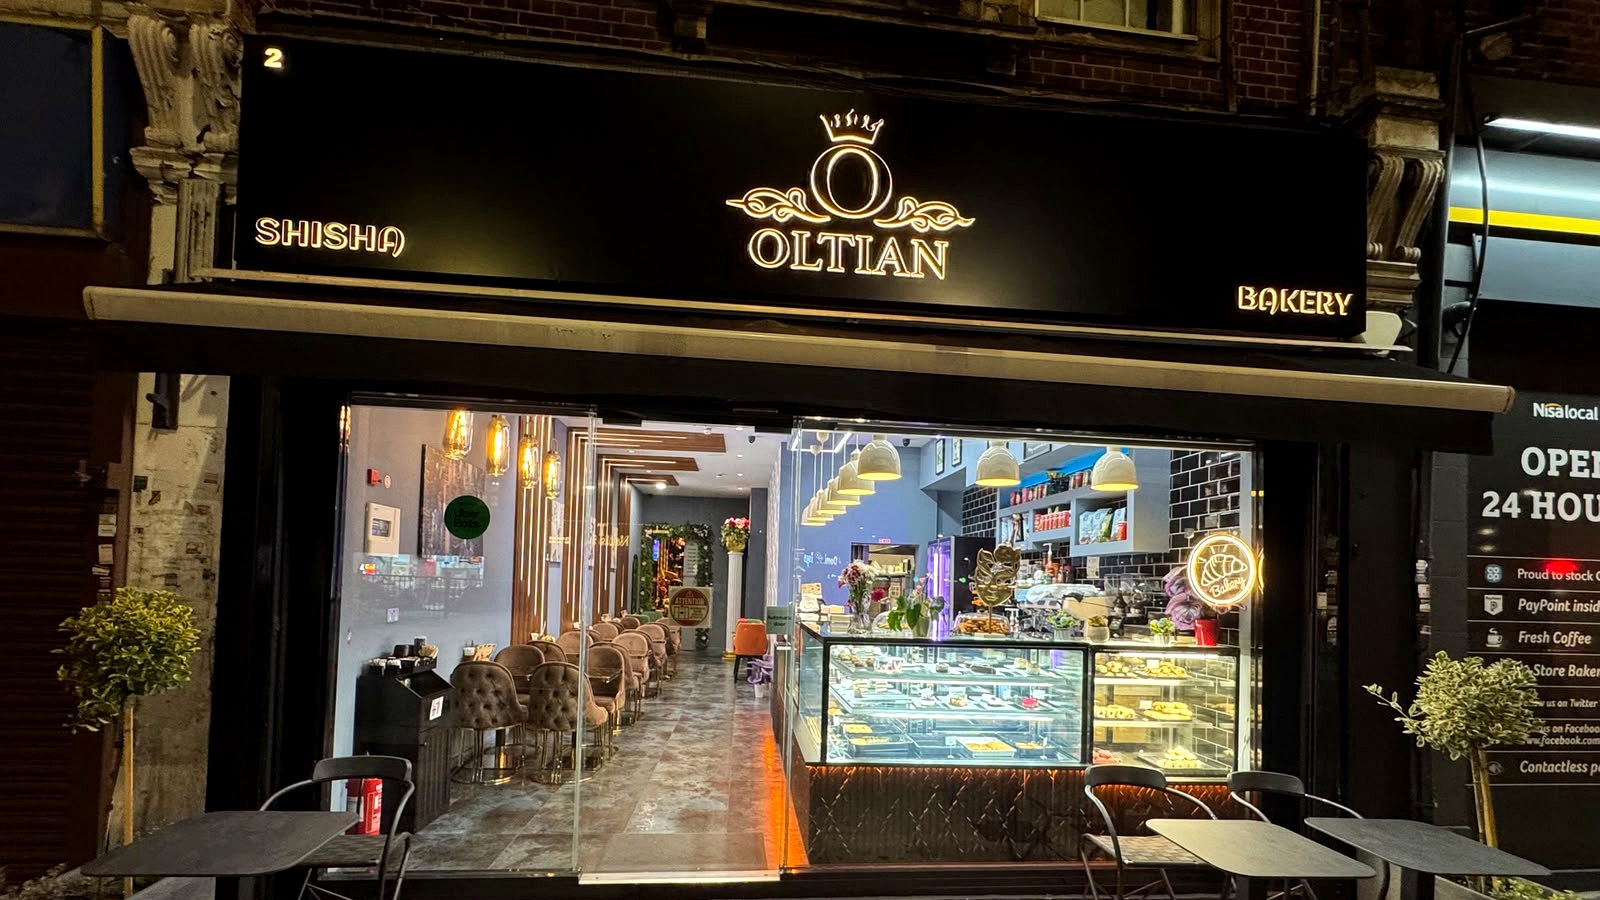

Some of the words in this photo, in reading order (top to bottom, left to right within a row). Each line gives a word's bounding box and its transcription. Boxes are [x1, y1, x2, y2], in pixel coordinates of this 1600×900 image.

[264, 48, 282, 68] 2
[255, 217, 405, 257] SHISHA
[749, 228, 949, 280] OLTIAN
[1238, 285, 1353, 315] BAKERY
[1482, 491, 1521, 518] 24
[1517, 568, 1549, 580] Proud
[1551, 570, 1563, 580] to
[1565, 570, 1594, 581] stock
[1209, 577, 1247, 597] Bakery
[1518, 598, 1571, 615] PayPoint
[1518, 630, 1550, 643] Fresh
[1552, 631, 1592, 647] Coffee
[1546, 700, 1556, 708] us
[1557, 700, 1568, 708] on
[1569, 698, 1598, 708] Twitter
[1552, 726, 1563, 734] on
[1520, 760, 1588, 774] Contactless
